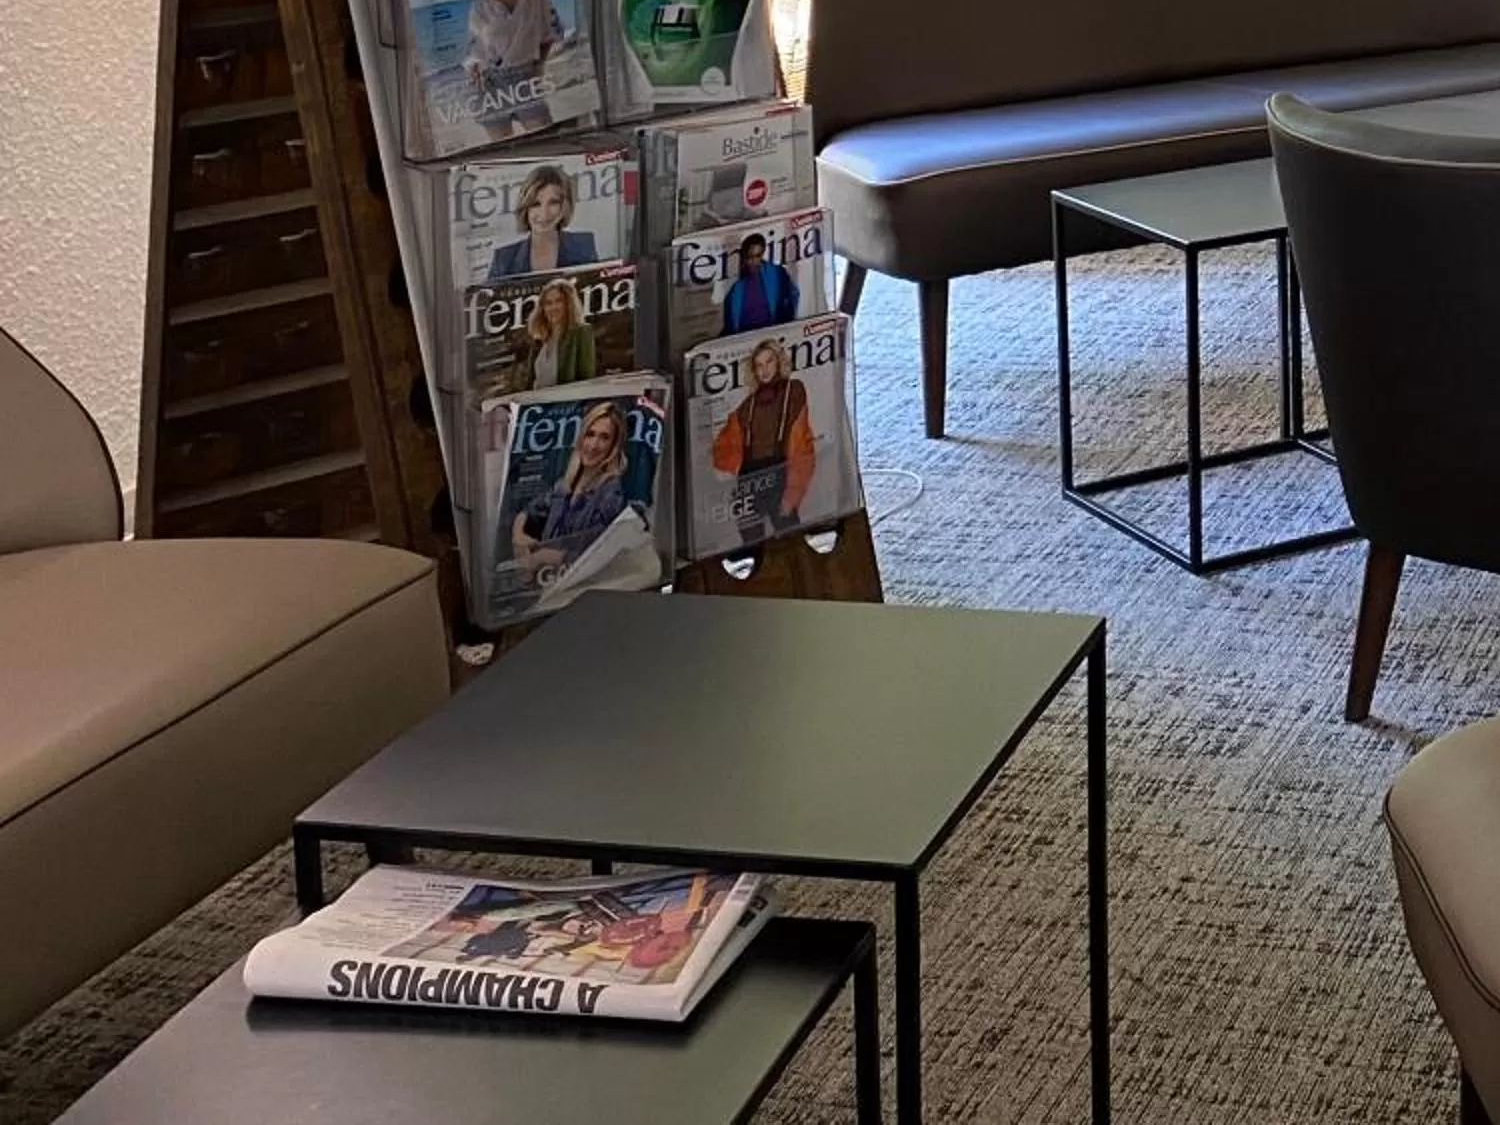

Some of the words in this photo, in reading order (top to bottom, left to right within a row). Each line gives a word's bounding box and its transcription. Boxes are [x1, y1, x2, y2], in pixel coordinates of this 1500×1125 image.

[453, 161, 624, 222] fena
[463, 277, 637, 340] fena
[687, 332, 836, 398] fena
[511, 405, 666, 454] femna
[327, 959, 565, 1013] CHAMPIONS
